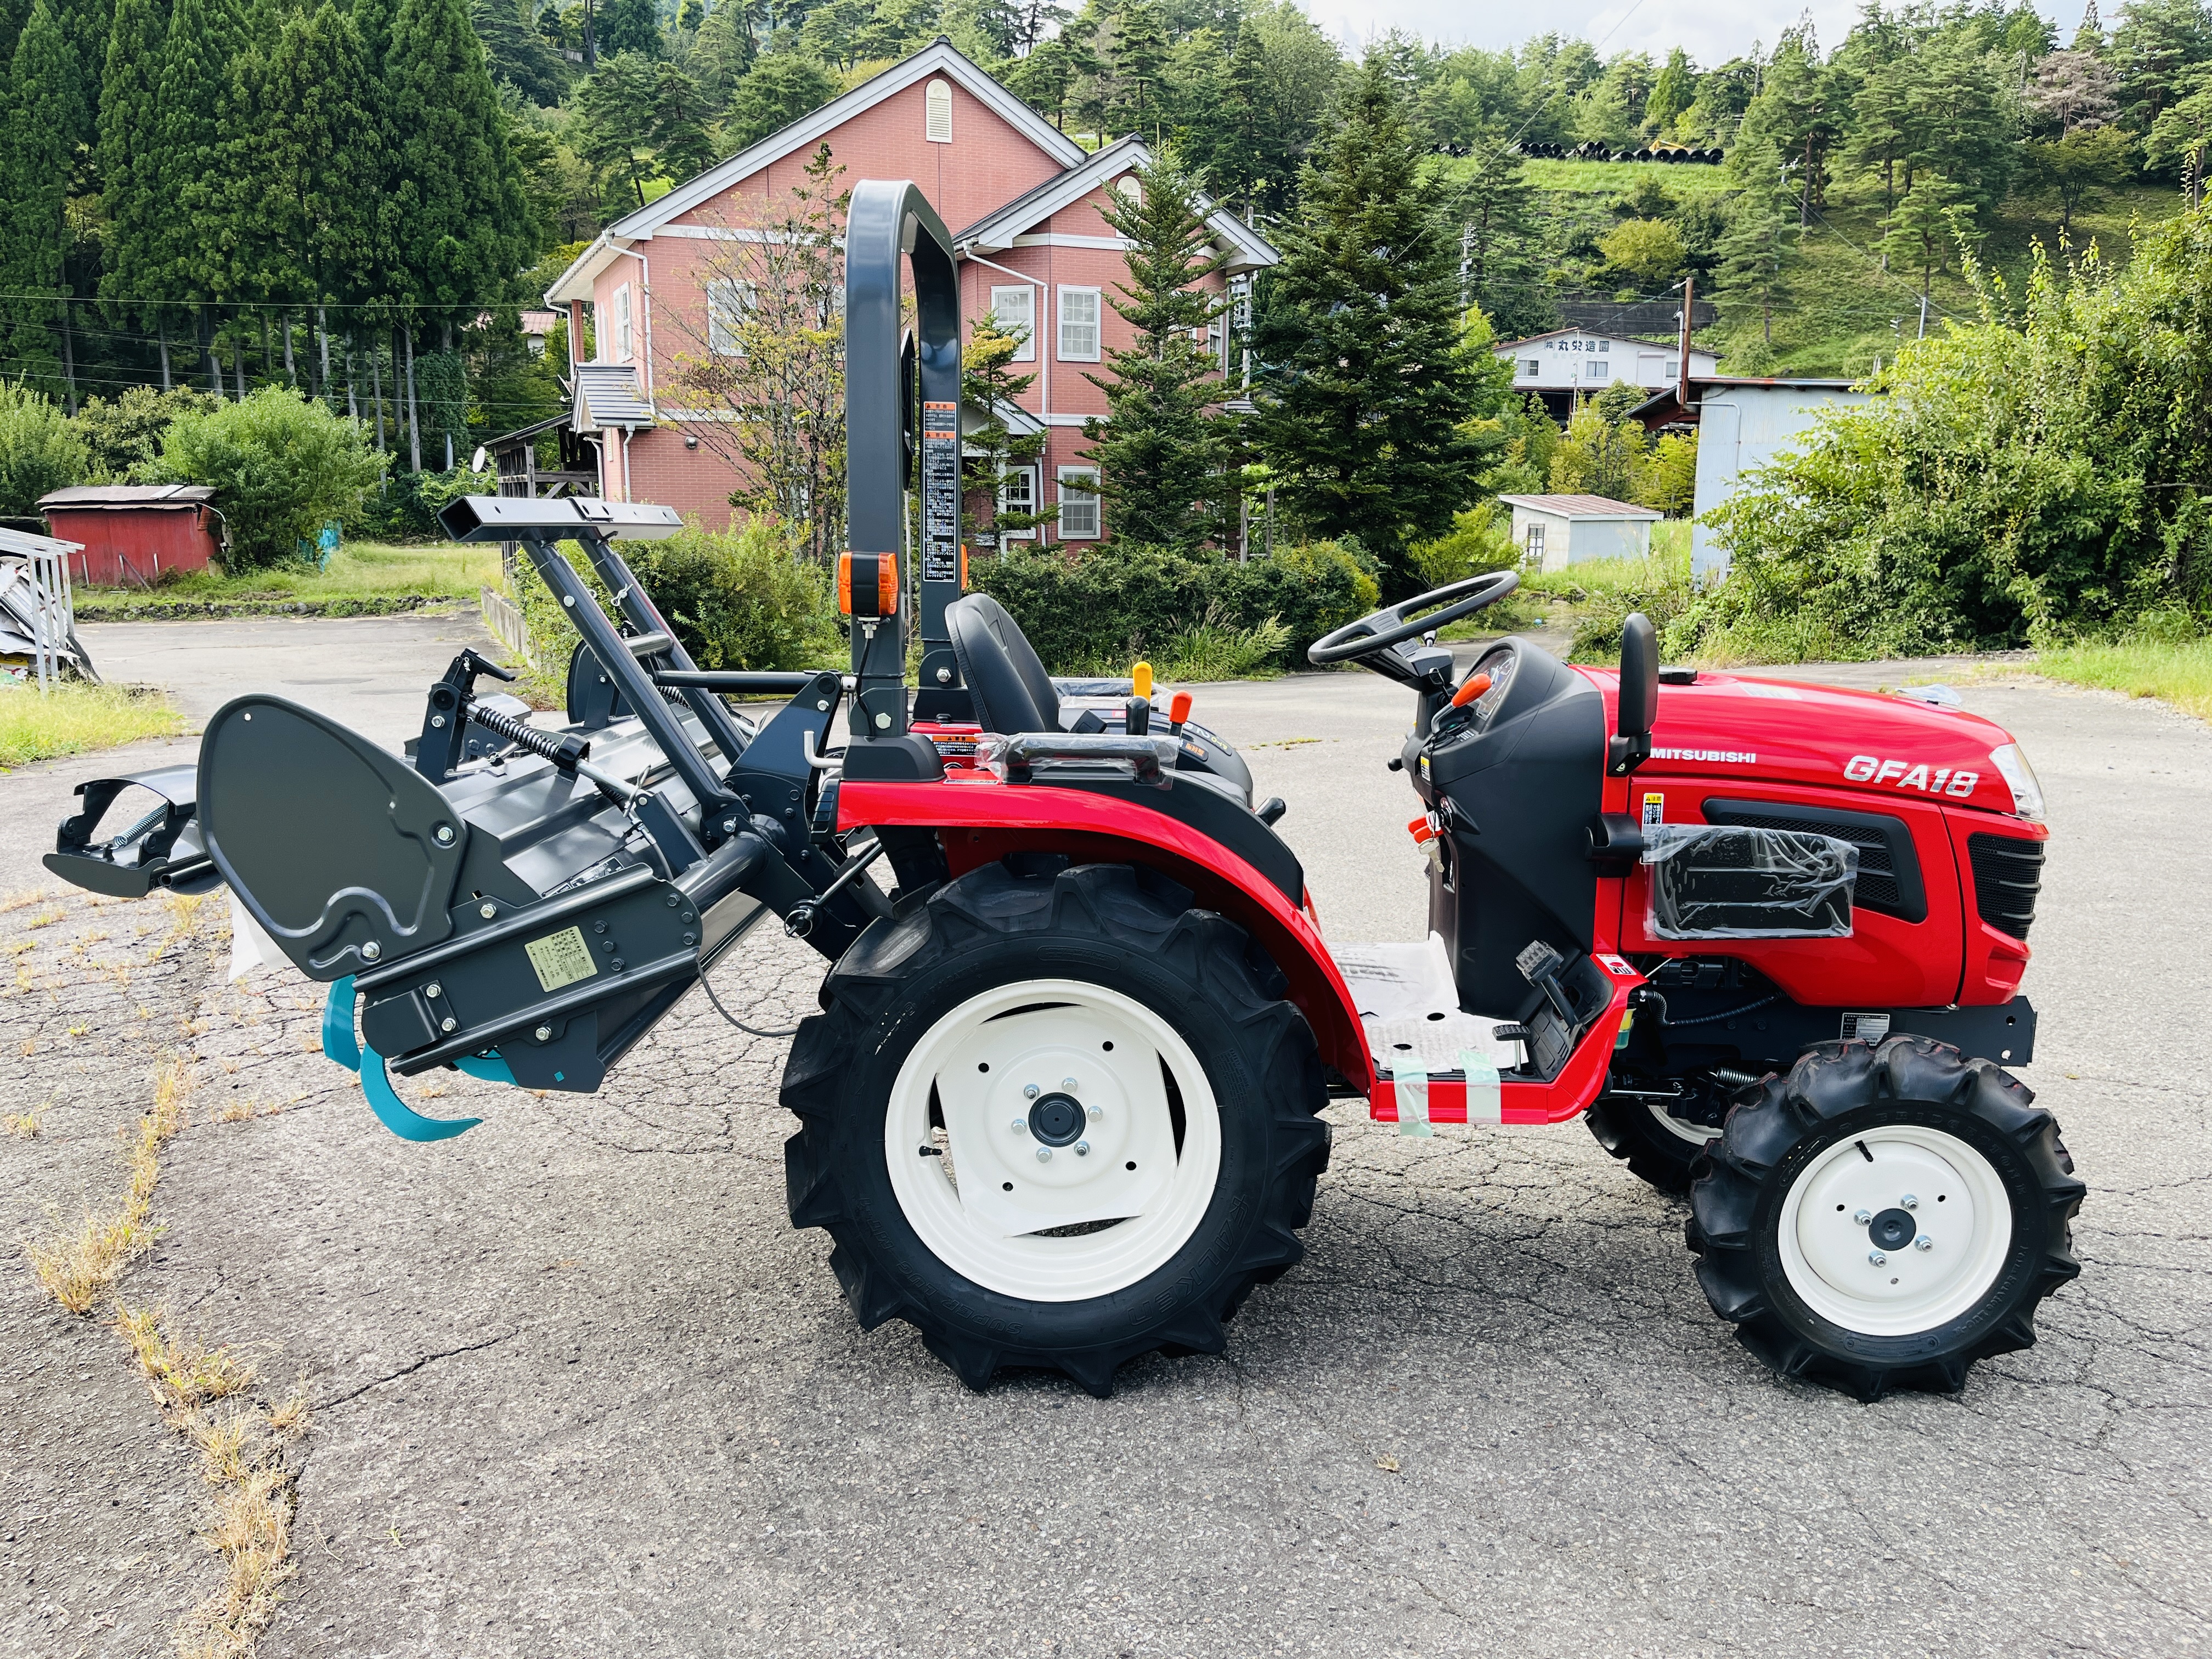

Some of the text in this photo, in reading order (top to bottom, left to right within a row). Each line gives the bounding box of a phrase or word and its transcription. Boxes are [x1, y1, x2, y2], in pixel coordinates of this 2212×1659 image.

[1650, 748, 1756, 764] MITSUBISHI
[1843, 755, 1979, 798] GFA18
[1127, 1194, 1249, 1325] FALKEN
[896, 1260, 938, 1299] LUG
[941, 1299, 1024, 1334] SUPER
